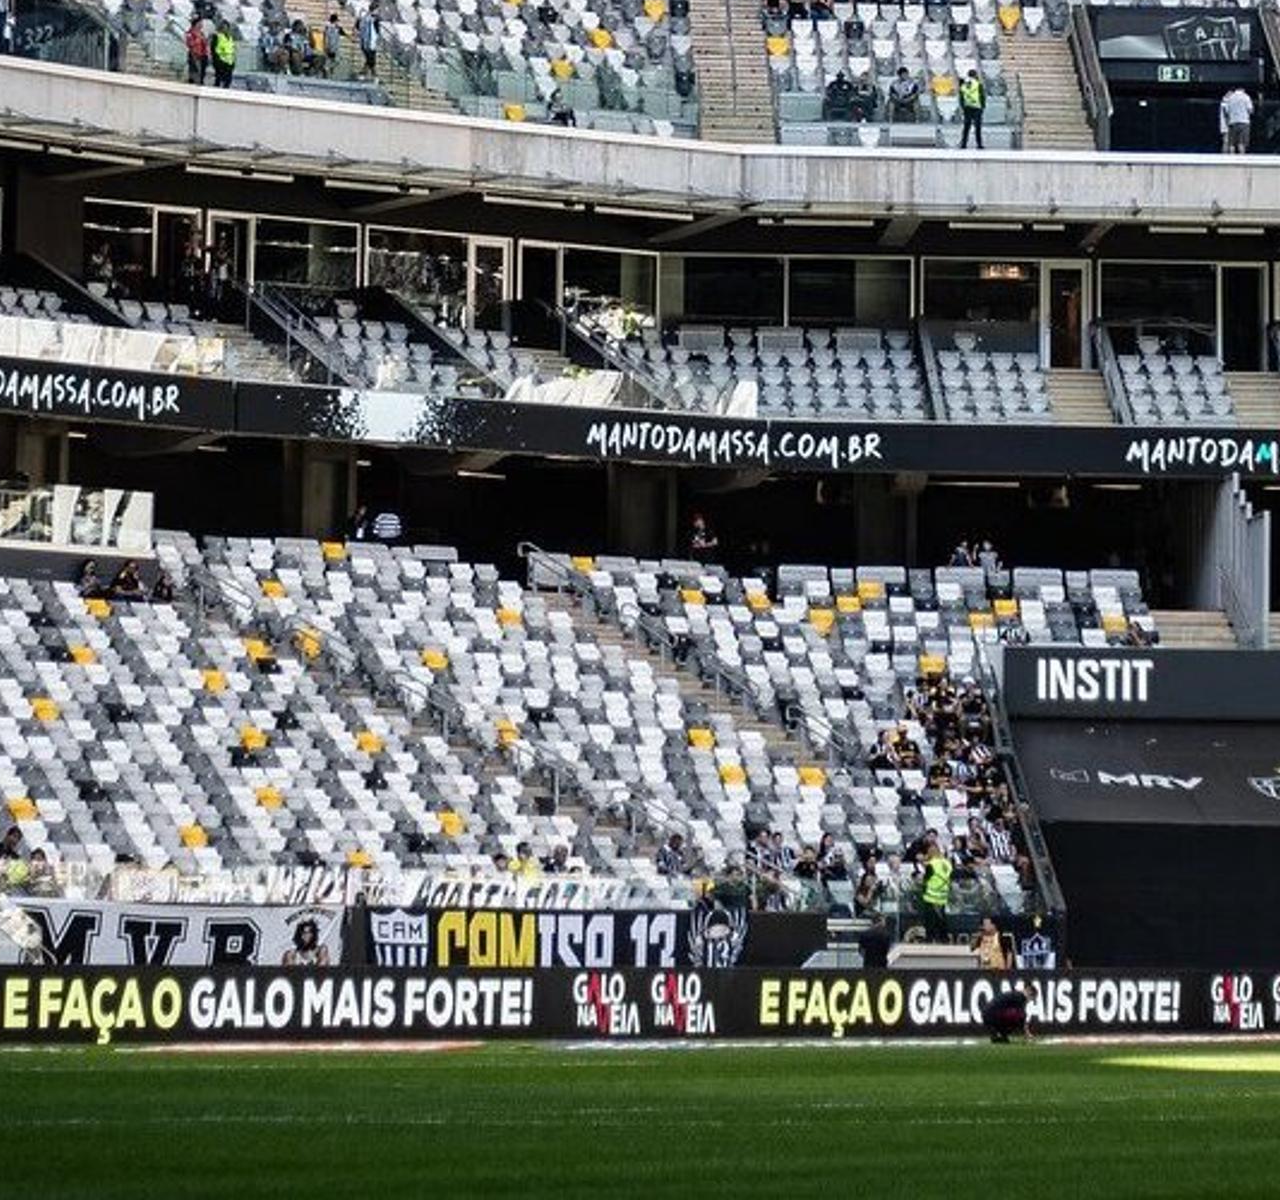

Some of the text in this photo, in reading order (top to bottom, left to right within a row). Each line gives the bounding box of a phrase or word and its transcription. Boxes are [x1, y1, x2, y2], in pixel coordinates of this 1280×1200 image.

[587, 422, 882, 468] MANTODAMASSA.COM.BR
[1037, 659, 1153, 701] INSTIT
[1097, 770, 1204, 790] MRV
[377, 918, 423, 939] CAM
[573, 971, 626, 1004] GALO
[651, 971, 702, 1004] GALO
[1211, 974, 1253, 1002] GALO
[4, 979, 30, 1029] E
[38, 978, 140, 1043] FAÇA
[143, 978, 182, 1029] O
[190, 978, 300, 1028] GALO
[303, 978, 398, 1027] MAIS
[404, 978, 533, 1026] FORTE!
[577, 1004, 597, 1026] NA
[654, 1004, 674, 1026] NA
[760, 981, 779, 1024] E
[787, 980, 873, 1038] FAÇA
[877, 979, 904, 1024] O
[1079, 980, 1180, 1023] FORTE!
